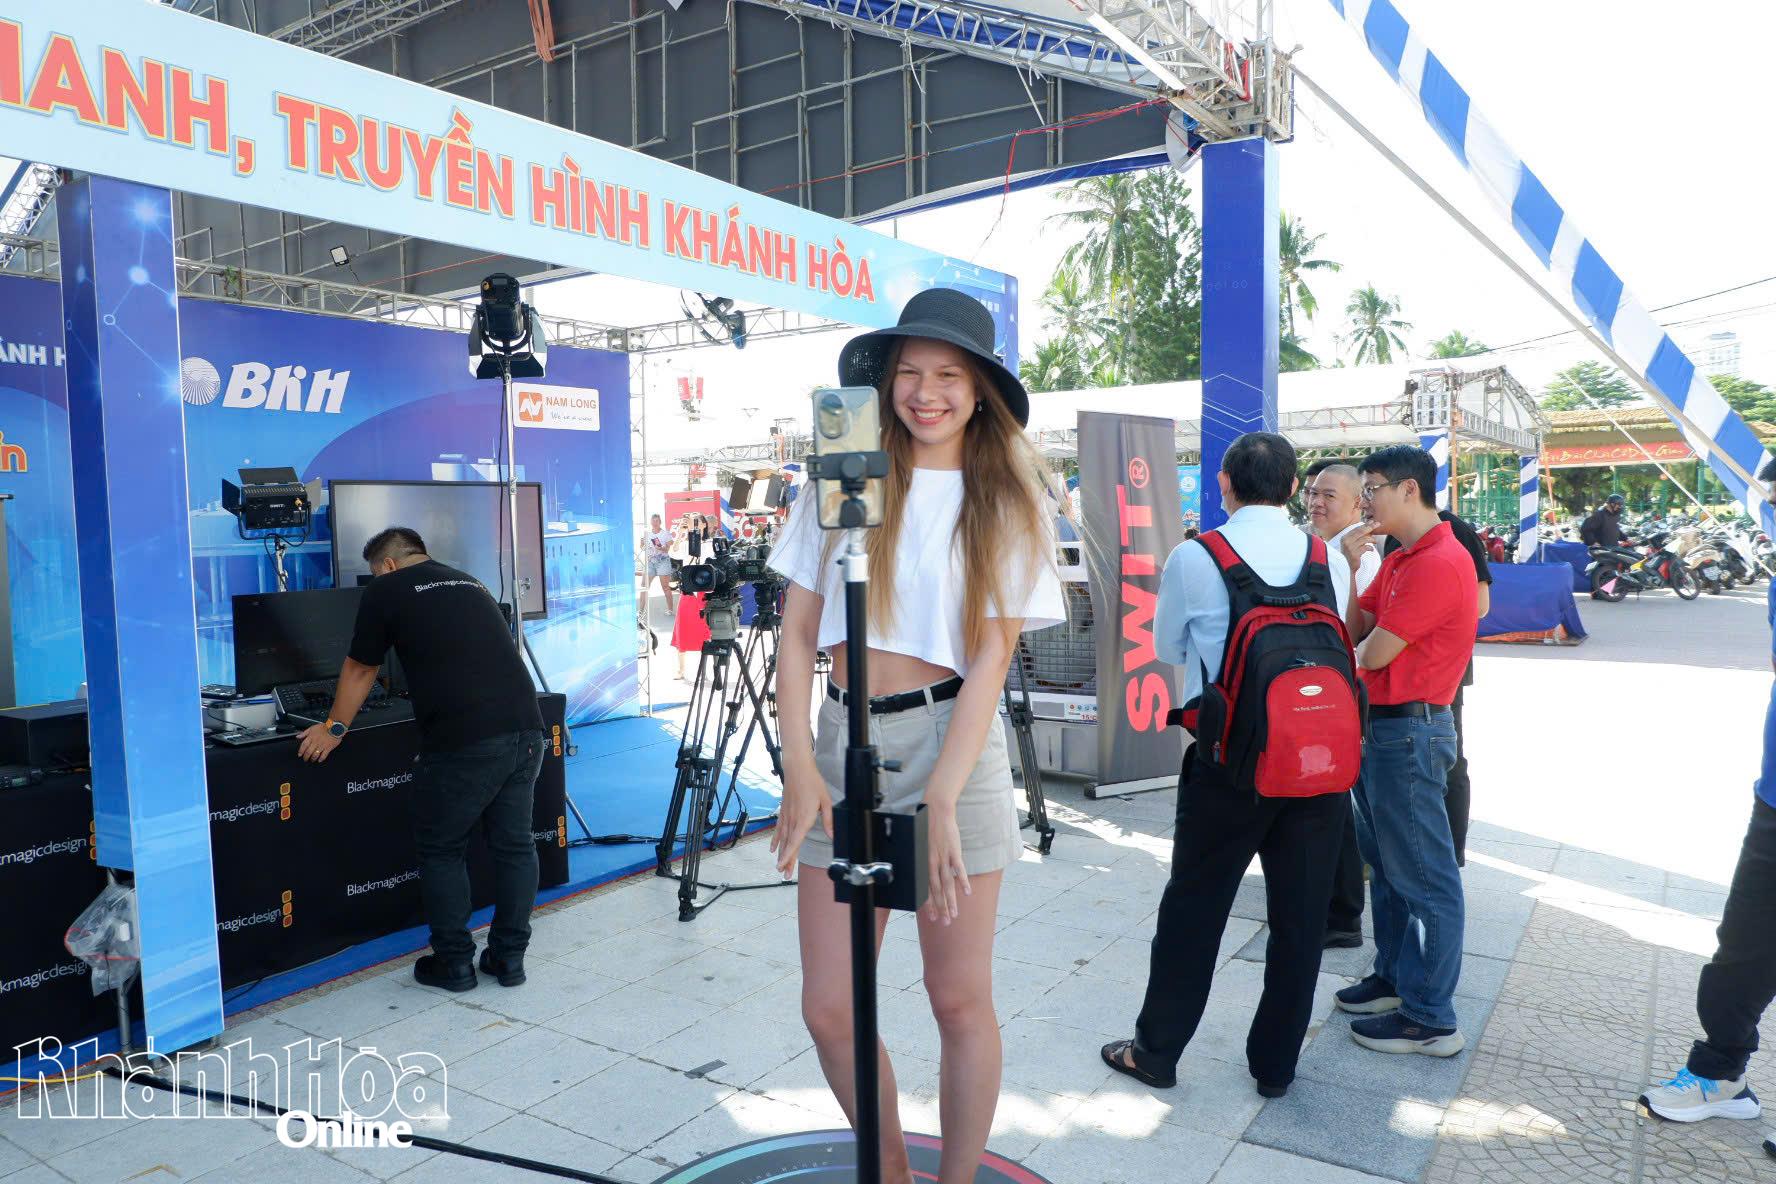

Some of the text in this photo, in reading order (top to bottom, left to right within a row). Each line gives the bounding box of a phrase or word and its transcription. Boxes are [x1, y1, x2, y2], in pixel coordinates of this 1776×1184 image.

[274, 91, 515, 220] TRUYỀN
[529, 153, 650, 250] HÌNH
[664, 199, 798, 284] KHÁNH
[807, 238, 875, 304] HÒA
[546, 396, 597, 410] NAM LONG
[1115, 484, 1170, 734] SWIT
[347, 771, 413, 794] Blackmagicde
[208, 799, 280, 821] magicdesign
